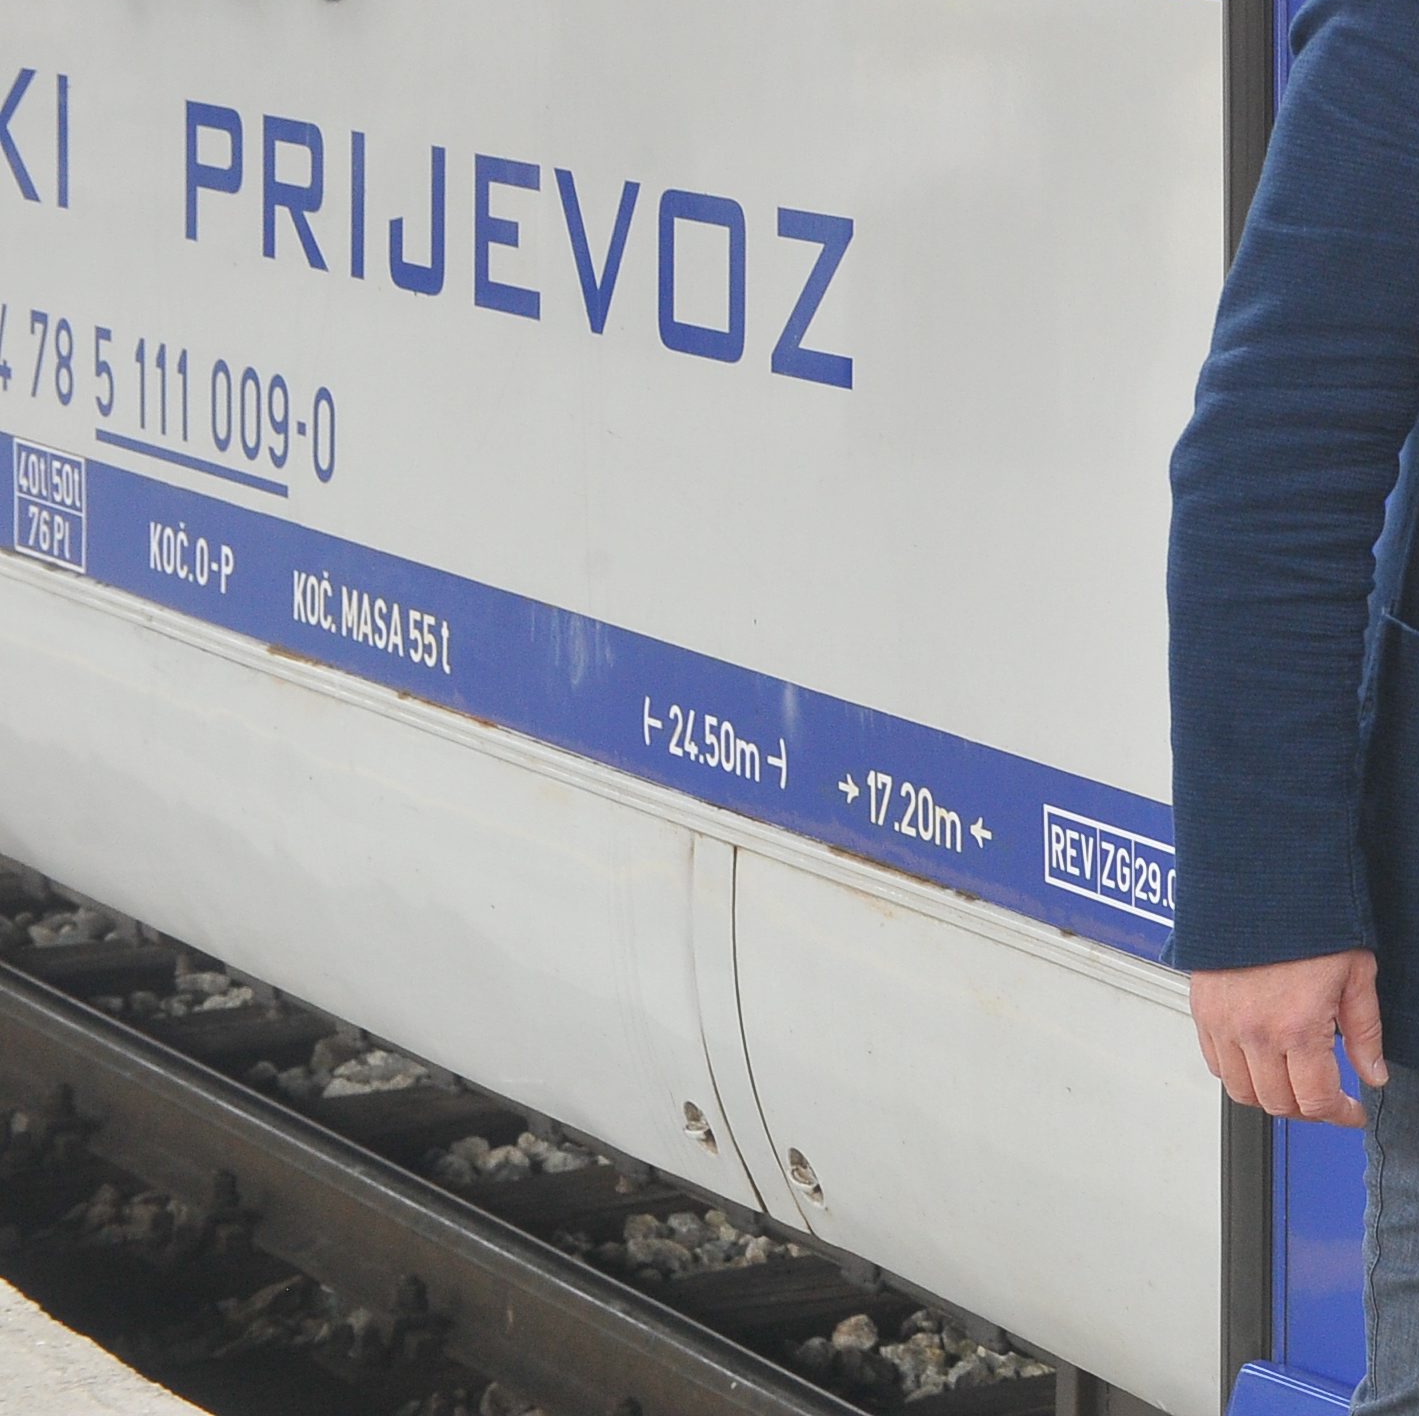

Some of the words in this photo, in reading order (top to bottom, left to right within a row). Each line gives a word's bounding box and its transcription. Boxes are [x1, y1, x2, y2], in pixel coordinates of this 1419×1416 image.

[185, 99, 854, 390] PRIJEVOZ
[30, 309, 74, 406] 78
[94, 325, 114, 417] 5
[135, 338, 188, 442] 111
[211, 359, 336, 483] 009-0
[341, 585, 404, 657] MASA
[668, 704, 760, 782] 24.50m
[867, 770, 962, 852] 17.20m
[1051, 824, 1094, 880] REV
[1101, 841, 1131, 893] ZG
